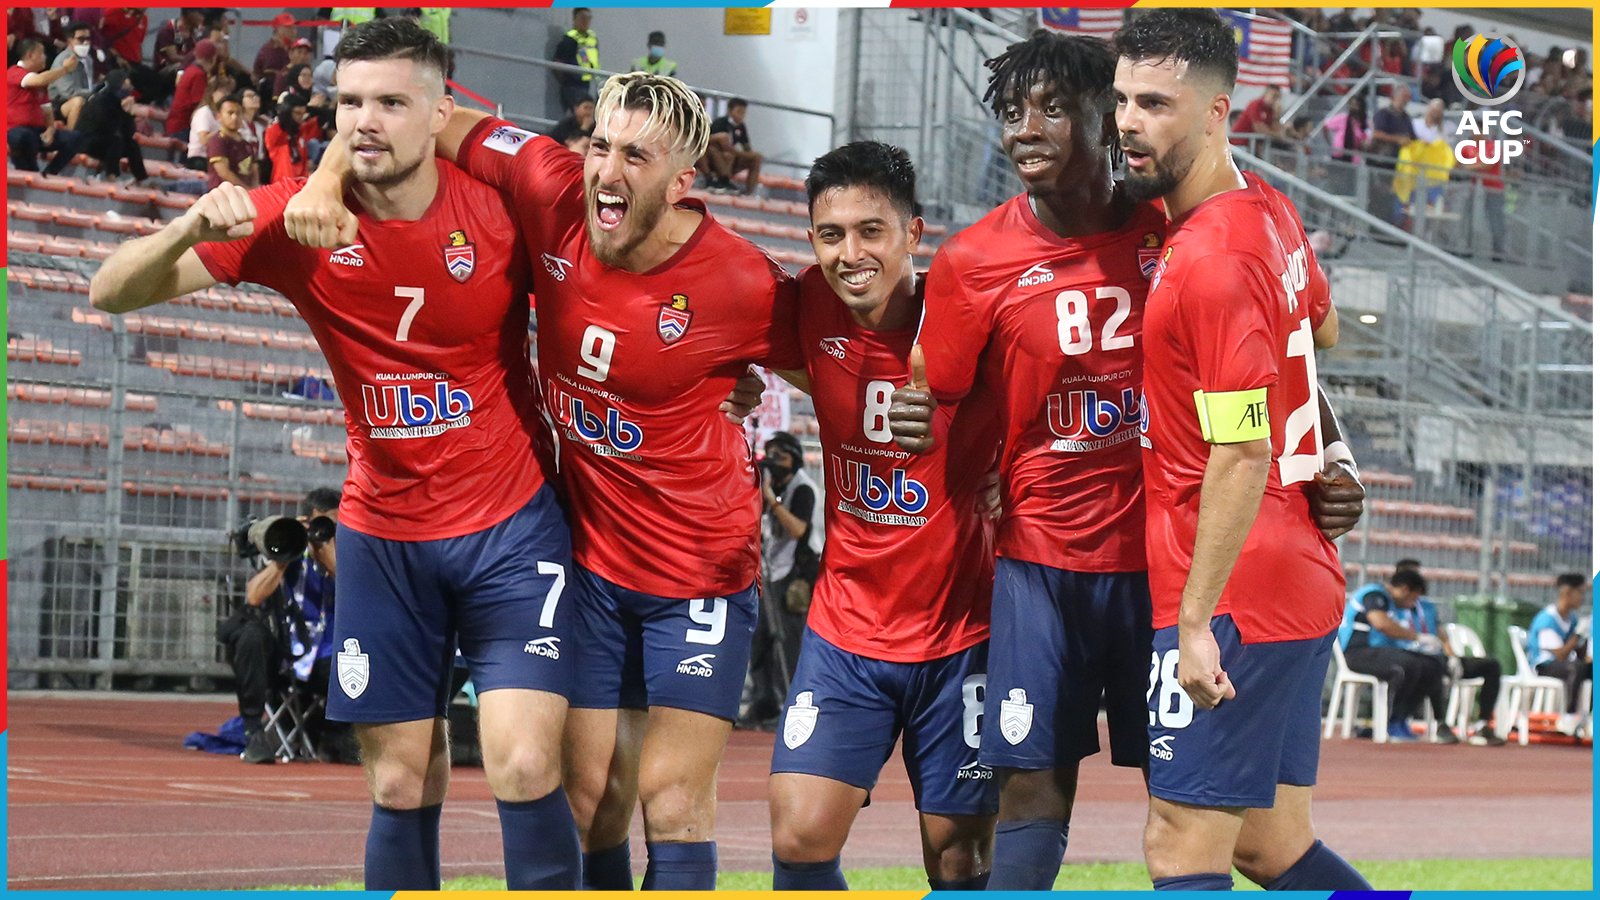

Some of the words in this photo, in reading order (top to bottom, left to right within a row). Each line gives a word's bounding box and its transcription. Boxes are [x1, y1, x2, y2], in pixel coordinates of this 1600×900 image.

[394, 285, 425, 342] 7
[1055, 286, 1134, 356] 82
[375, 373, 401, 381] KUALA
[401, 372, 434, 381] LUMPUR
[576, 324, 616, 383] 9
[556, 371, 578, 388] KUALA
[578, 383, 609, 399] LUMPUR
[1061, 374, 1087, 385] KUALA
[1087, 373, 1118, 383] LUMPUR
[361, 381, 475, 427] Ubb
[863, 380, 897, 444] 8
[370, 427, 421, 439] AMANAH
[841, 443, 863, 454] KUALA
[864, 448, 894, 458] LUMPUR
[895, 452, 911, 460] CITY
[1105, 425, 1141, 448] BERHA
[831, 453, 929, 514] Ubb
[877, 514, 928, 526] BERHAD
[536, 560, 566, 629] 7
[685, 597, 728, 646] 9
[962, 673, 987, 749] 8
[1146, 649, 1194, 729] 28
